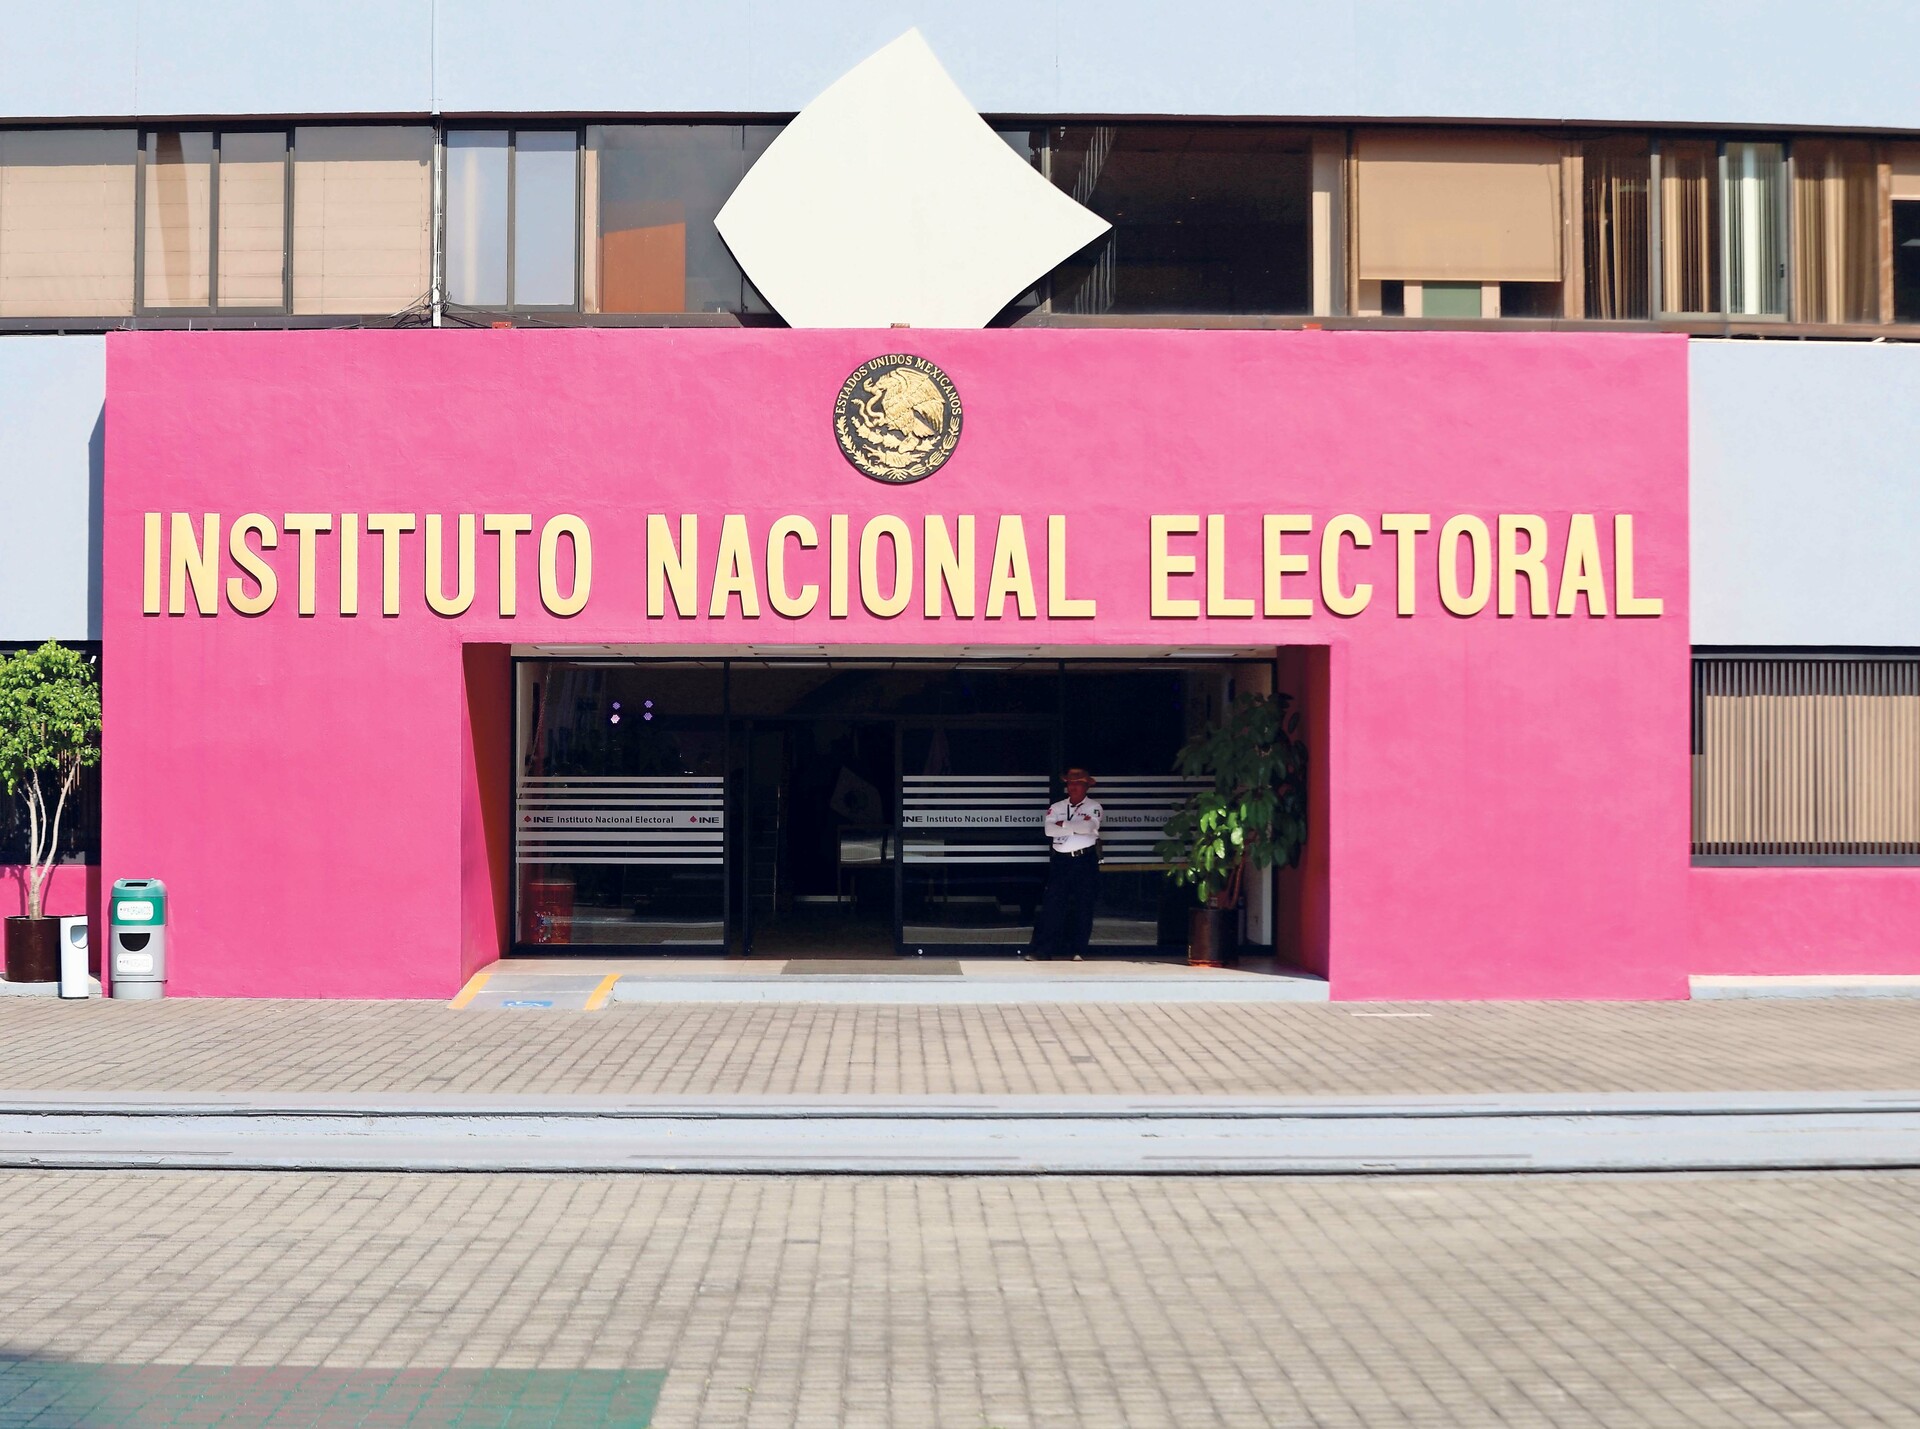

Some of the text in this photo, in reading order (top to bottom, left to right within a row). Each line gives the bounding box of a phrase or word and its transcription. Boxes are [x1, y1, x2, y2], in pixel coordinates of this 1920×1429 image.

[835, 354, 962, 416] ESTADOS UNIDOS MEXICANOS
[143, 512, 1664, 618] INSTITUTO NACIONAL ELECTORAL
[533, 815, 674, 824] INE Instituto Nacional Electoral
[699, 816, 720, 824] INE
[926, 815, 963, 823] Instituto
[964, 815, 1002, 823] Nacional
[1004, 815, 1043, 823] Electoral
[1105, 815, 1172, 823] Instituto Nacio
